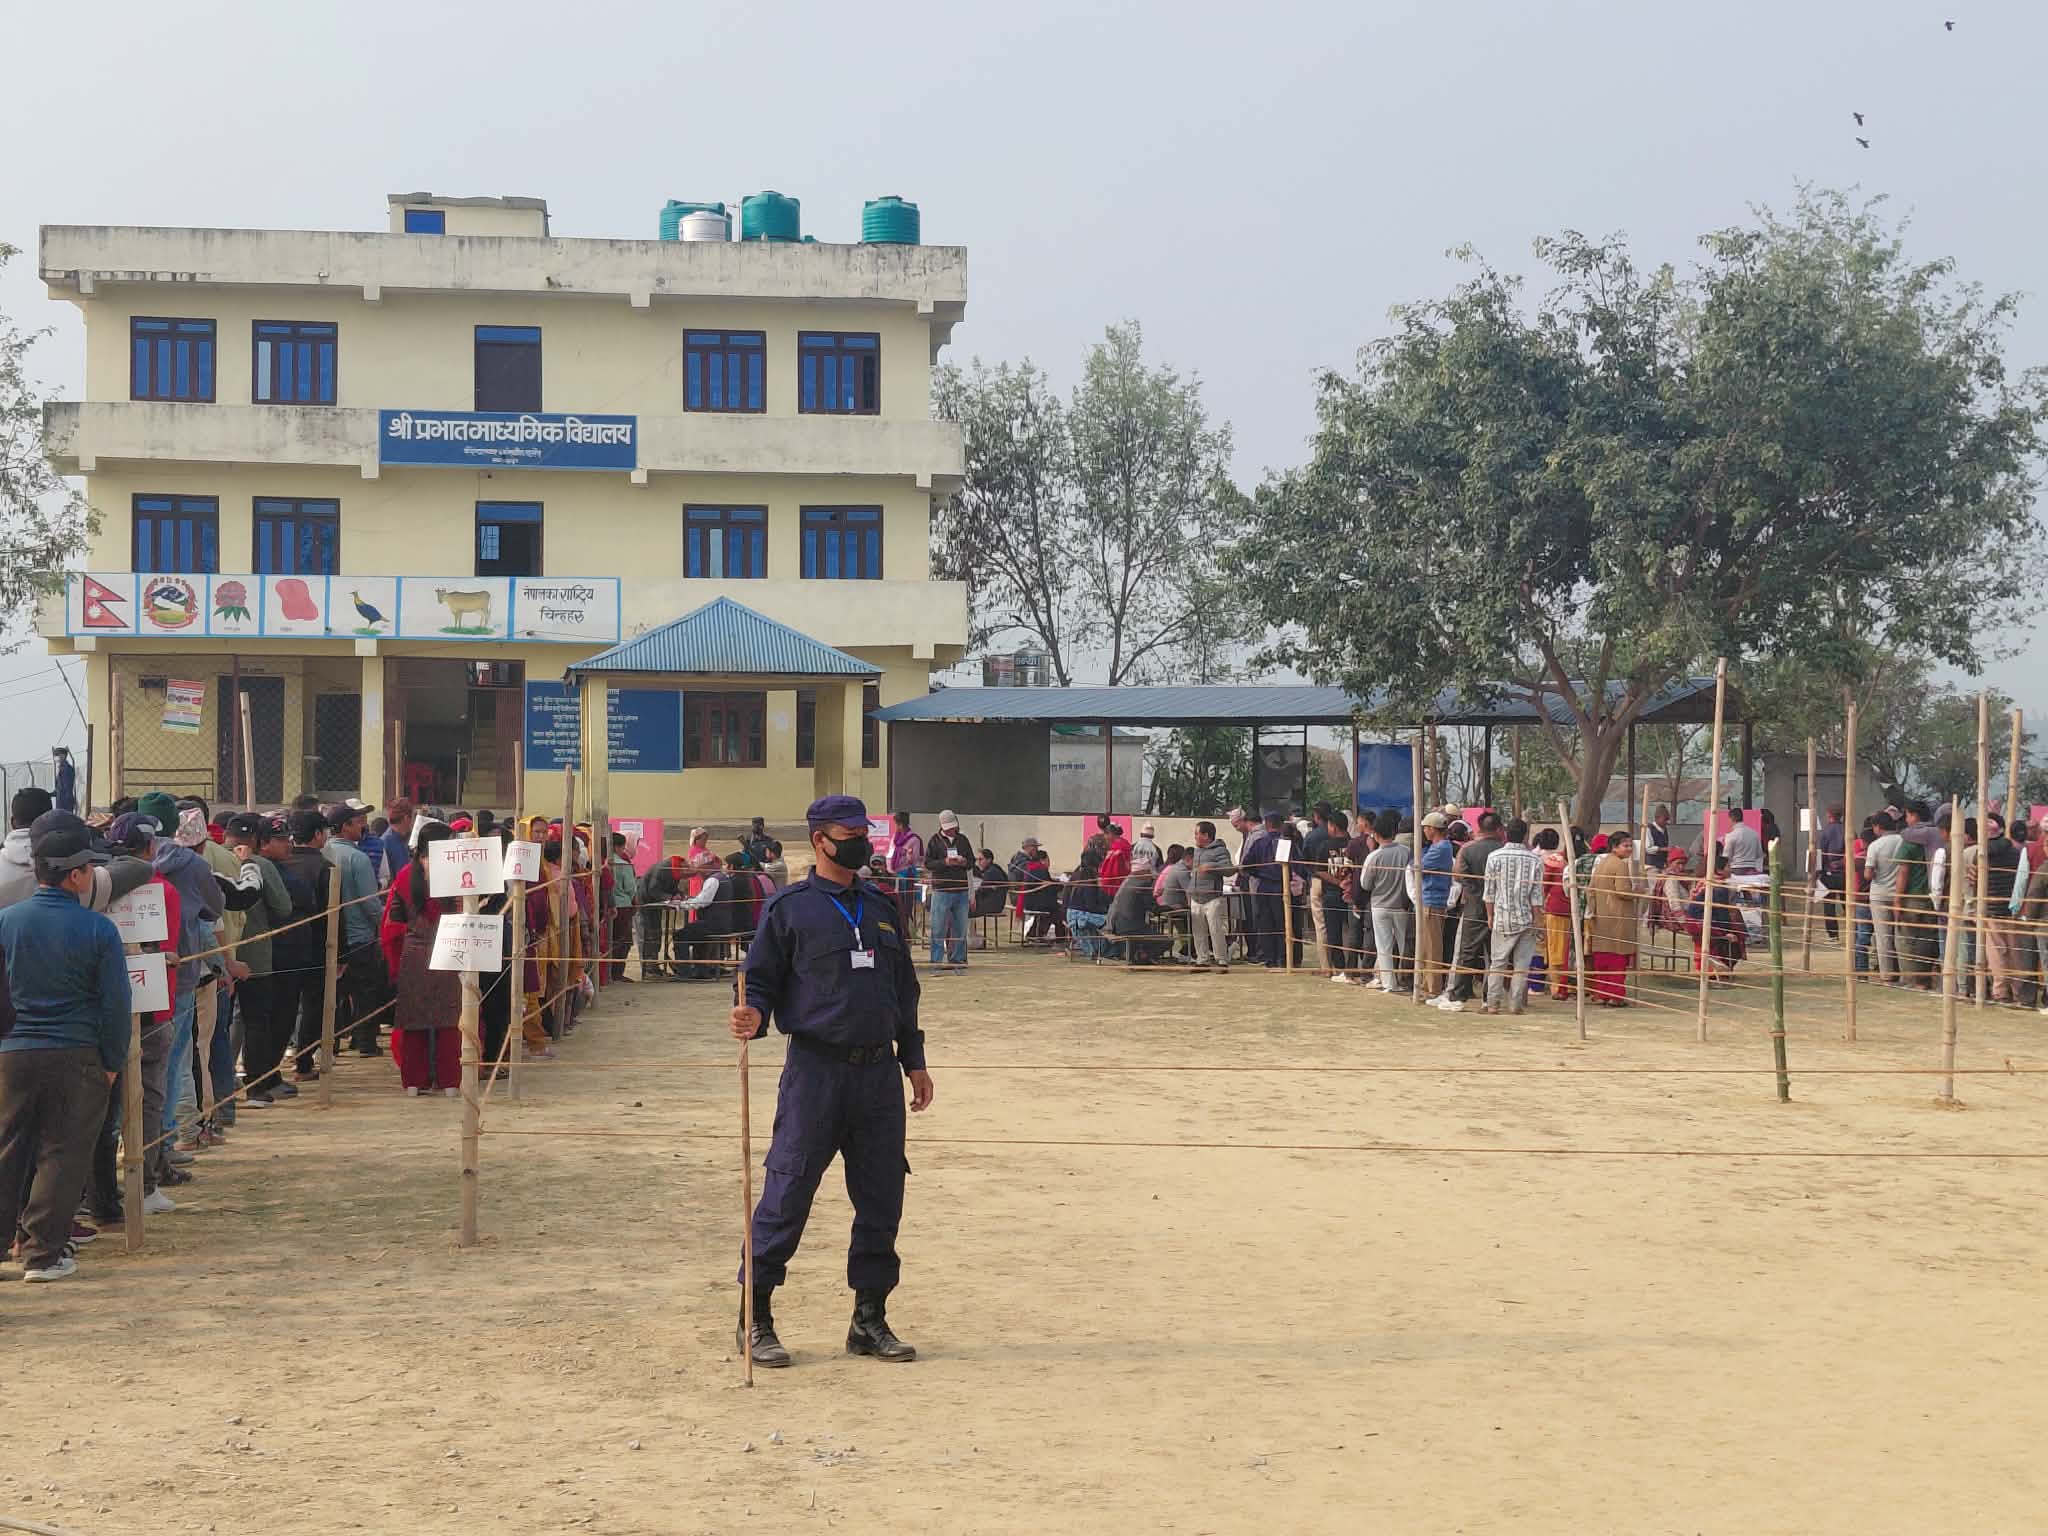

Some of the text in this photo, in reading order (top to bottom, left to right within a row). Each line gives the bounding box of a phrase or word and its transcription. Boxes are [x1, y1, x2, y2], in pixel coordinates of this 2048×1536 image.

[388, 412, 633, 445] श्री प्रभात माध्यमिक विद्यालय
[443, 847, 489, 864] महिला
